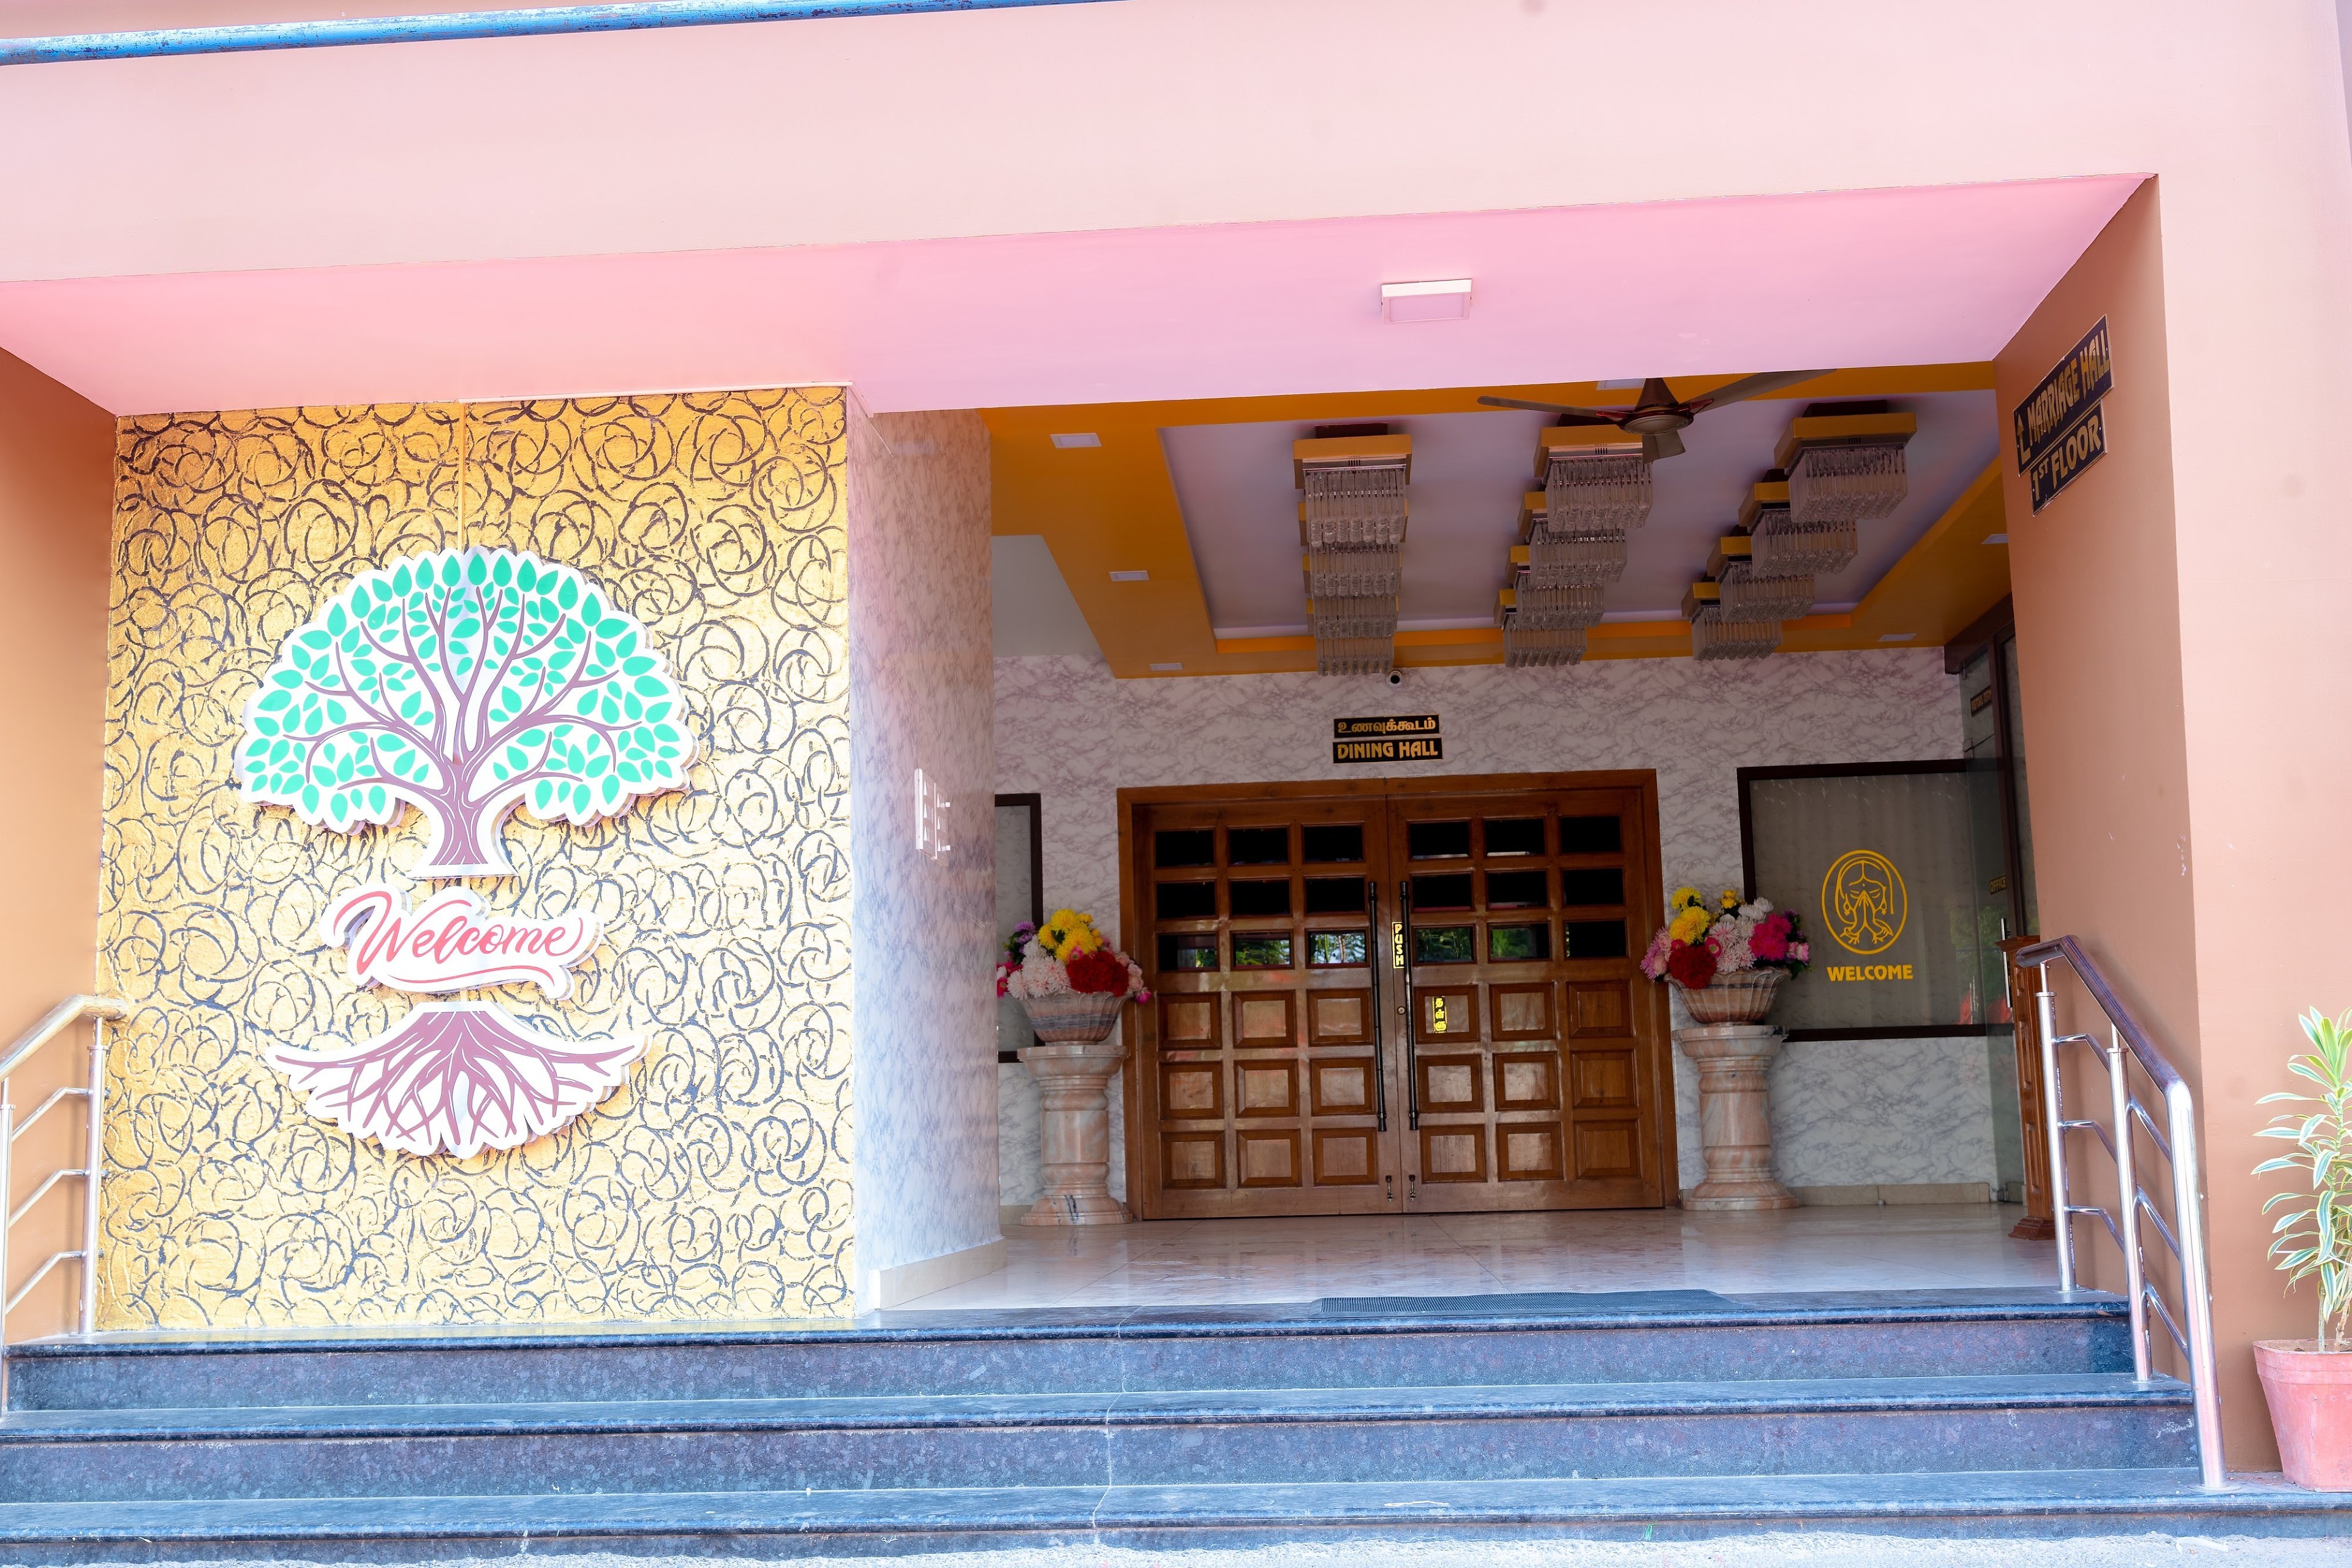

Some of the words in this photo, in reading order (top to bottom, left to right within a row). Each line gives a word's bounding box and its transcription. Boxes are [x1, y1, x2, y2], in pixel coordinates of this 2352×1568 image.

[2027, 358, 2081, 447] MARRIAGE
[2079, 329, 2111, 397] HALL
[2033, 458, 2049, 501] 1ST
[2051, 415, 2101, 489] FLOOR
[1338, 717, 1436, 734] உணவுக்கூடம்
[1337, 742, 1394, 760] DINING
[1399, 741, 1439, 759] HALL
[1989, 876, 2006, 892] OFFICE
[333, 890, 584, 976] Welcome
[1394, 924, 1404, 967] PUSH
[1826, 964, 1913, 982] WELCOME
